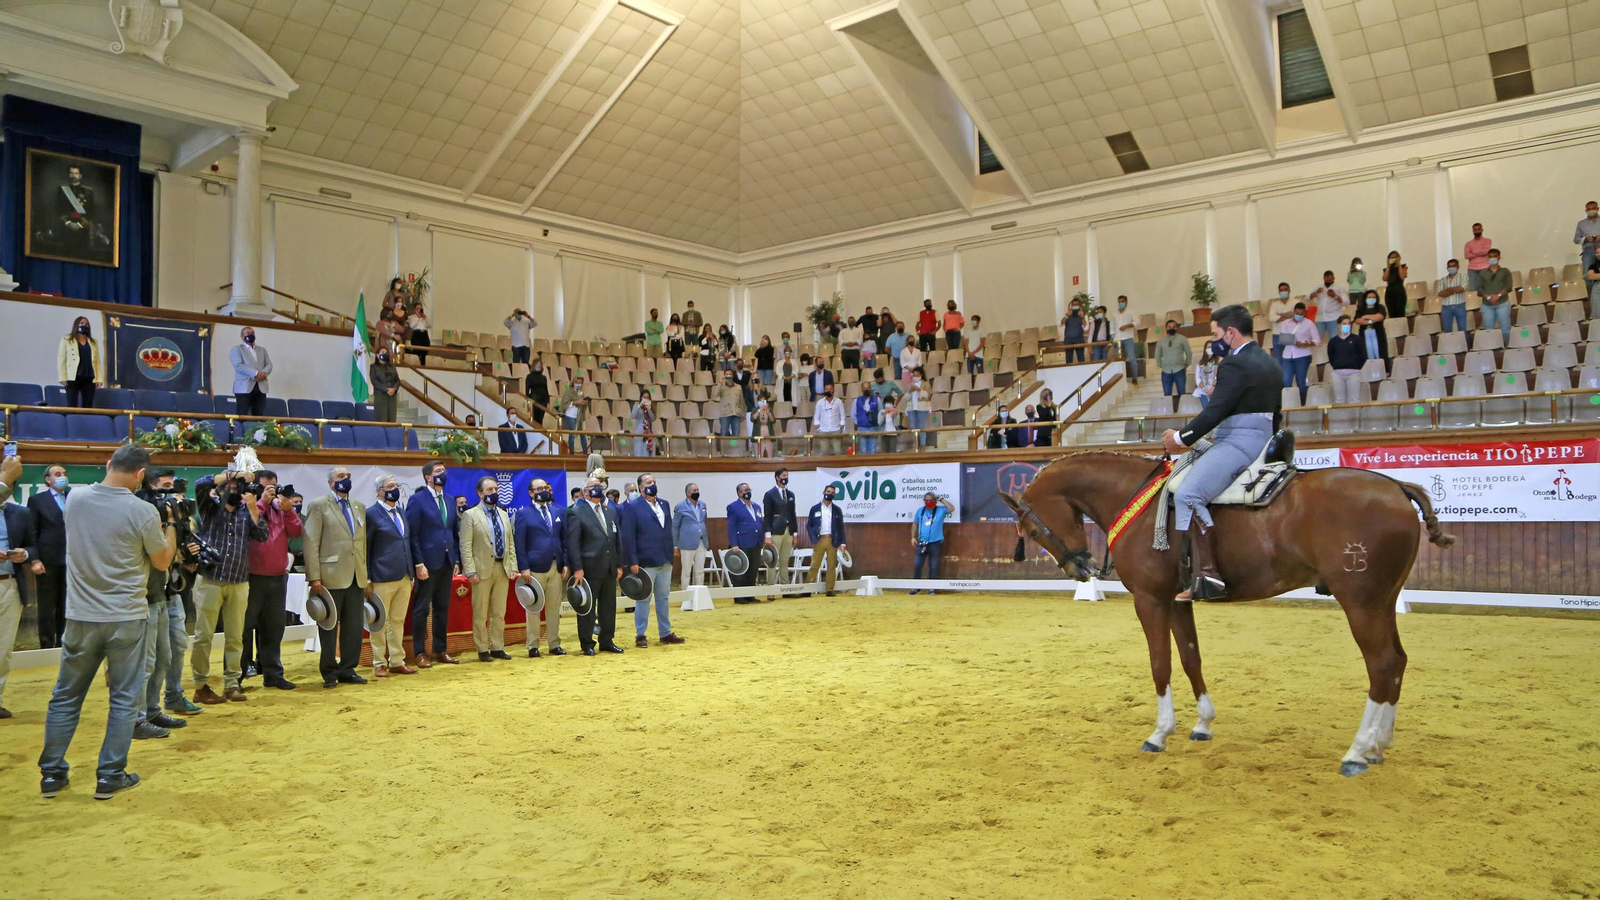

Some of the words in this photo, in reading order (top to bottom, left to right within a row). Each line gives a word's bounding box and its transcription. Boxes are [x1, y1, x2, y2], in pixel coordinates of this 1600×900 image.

[1353, 453, 1381, 463] Vive
[1384, 452, 1396, 462] la
[1400, 450, 1479, 465] experiencia
[1483, 448, 1518, 461] TIO
[1534, 445, 1585, 459] PEPE
[1293, 456, 1330, 466] BALLOS
[1486, 475, 1526, 483] BODEGA
[1417, 505, 1518, 517] w.tiopepe.com
